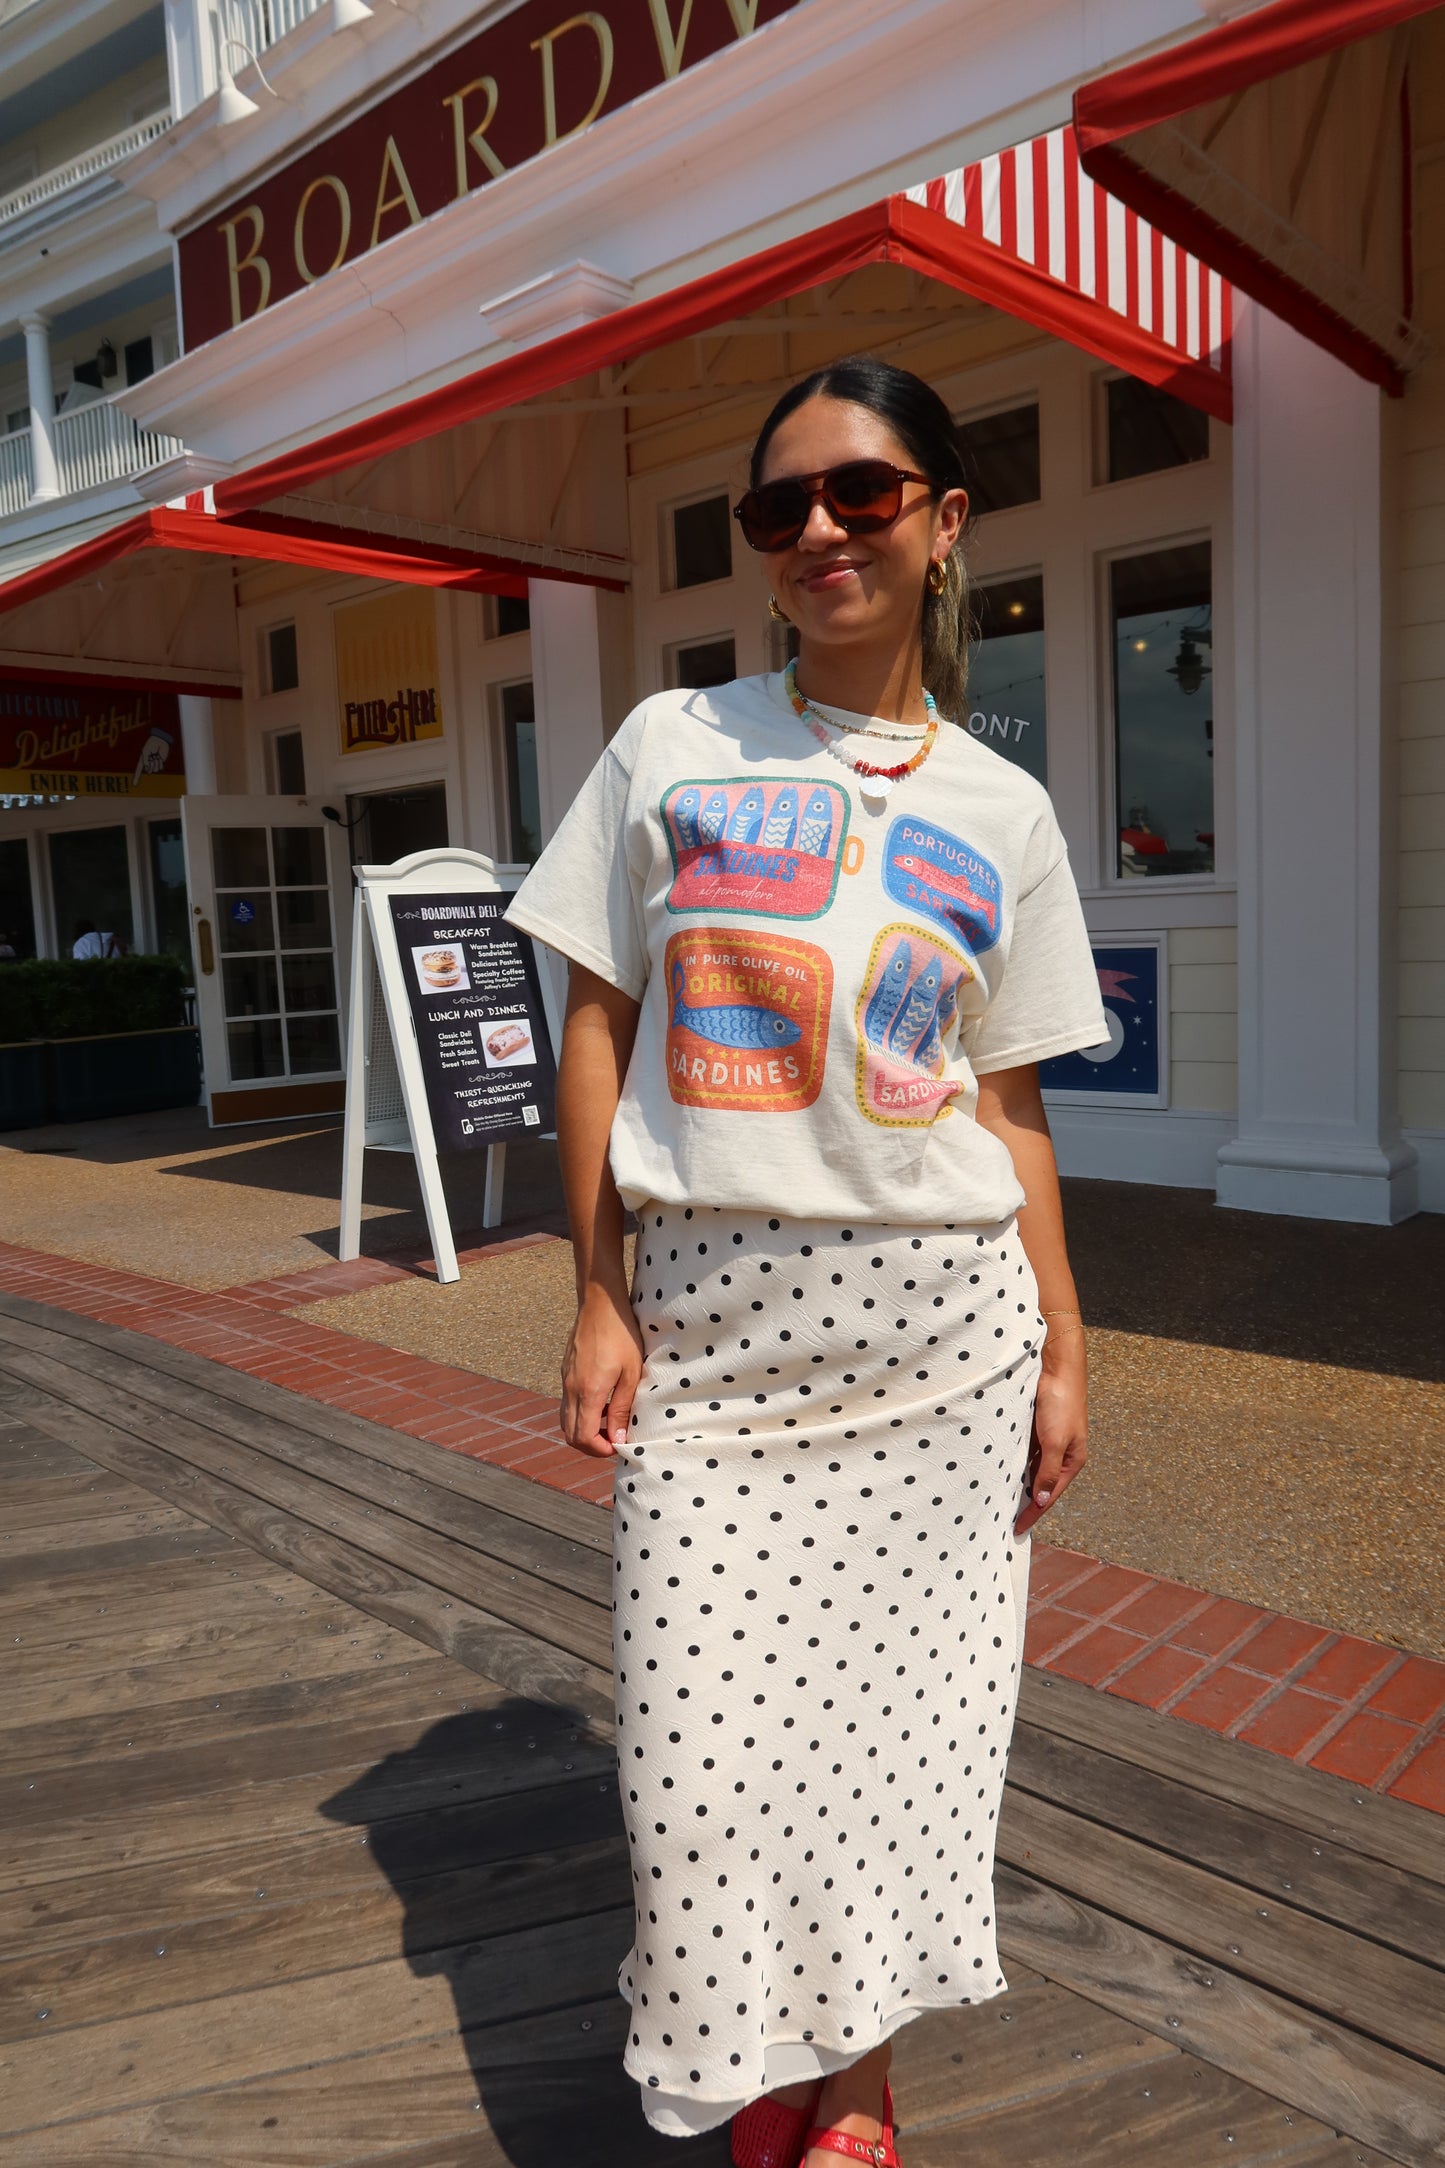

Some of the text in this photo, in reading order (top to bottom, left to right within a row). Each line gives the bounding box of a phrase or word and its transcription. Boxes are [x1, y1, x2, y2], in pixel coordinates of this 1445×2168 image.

[0, 693, 80, 719] LECTABLY
[11, 689, 152, 770] Delightful!
[967, 711, 1031, 743] ONT
[30, 773, 129, 793] ENTER HERE!
[693, 848, 800, 883] SARDINES
[902, 827, 998, 894] PORTUGUESE
[420, 904, 498, 921] BOARDWALK DELI
[906, 883, 981, 942] SARDINES
[433, 927, 491, 940] BREAKFAST
[469, 941, 518, 951] Warm Breakfast
[478, 949, 512, 957] Sandwiches
[471, 958, 523, 968] Delicious Pastries
[685, 953, 807, 982] IN PURE OLIVE OIL
[472, 968, 525, 979] Specialty Coffees
[689, 972, 801, 1011] ORIGINAL
[428, 1003, 528, 1022] LUNCH AND DINNER
[438, 1030, 472, 1040] Classic Deli
[439, 1039, 474, 1048] Sandwiches
[457, 1048, 477, 1056] Salads
[441, 1058, 480, 1069] Sweet Treats
[672, 1048, 799, 1086] SARDINES
[454, 1080, 533, 1099] THIRST-QUENCHING
[467, 1092, 526, 1108] REFRESHMENTS
